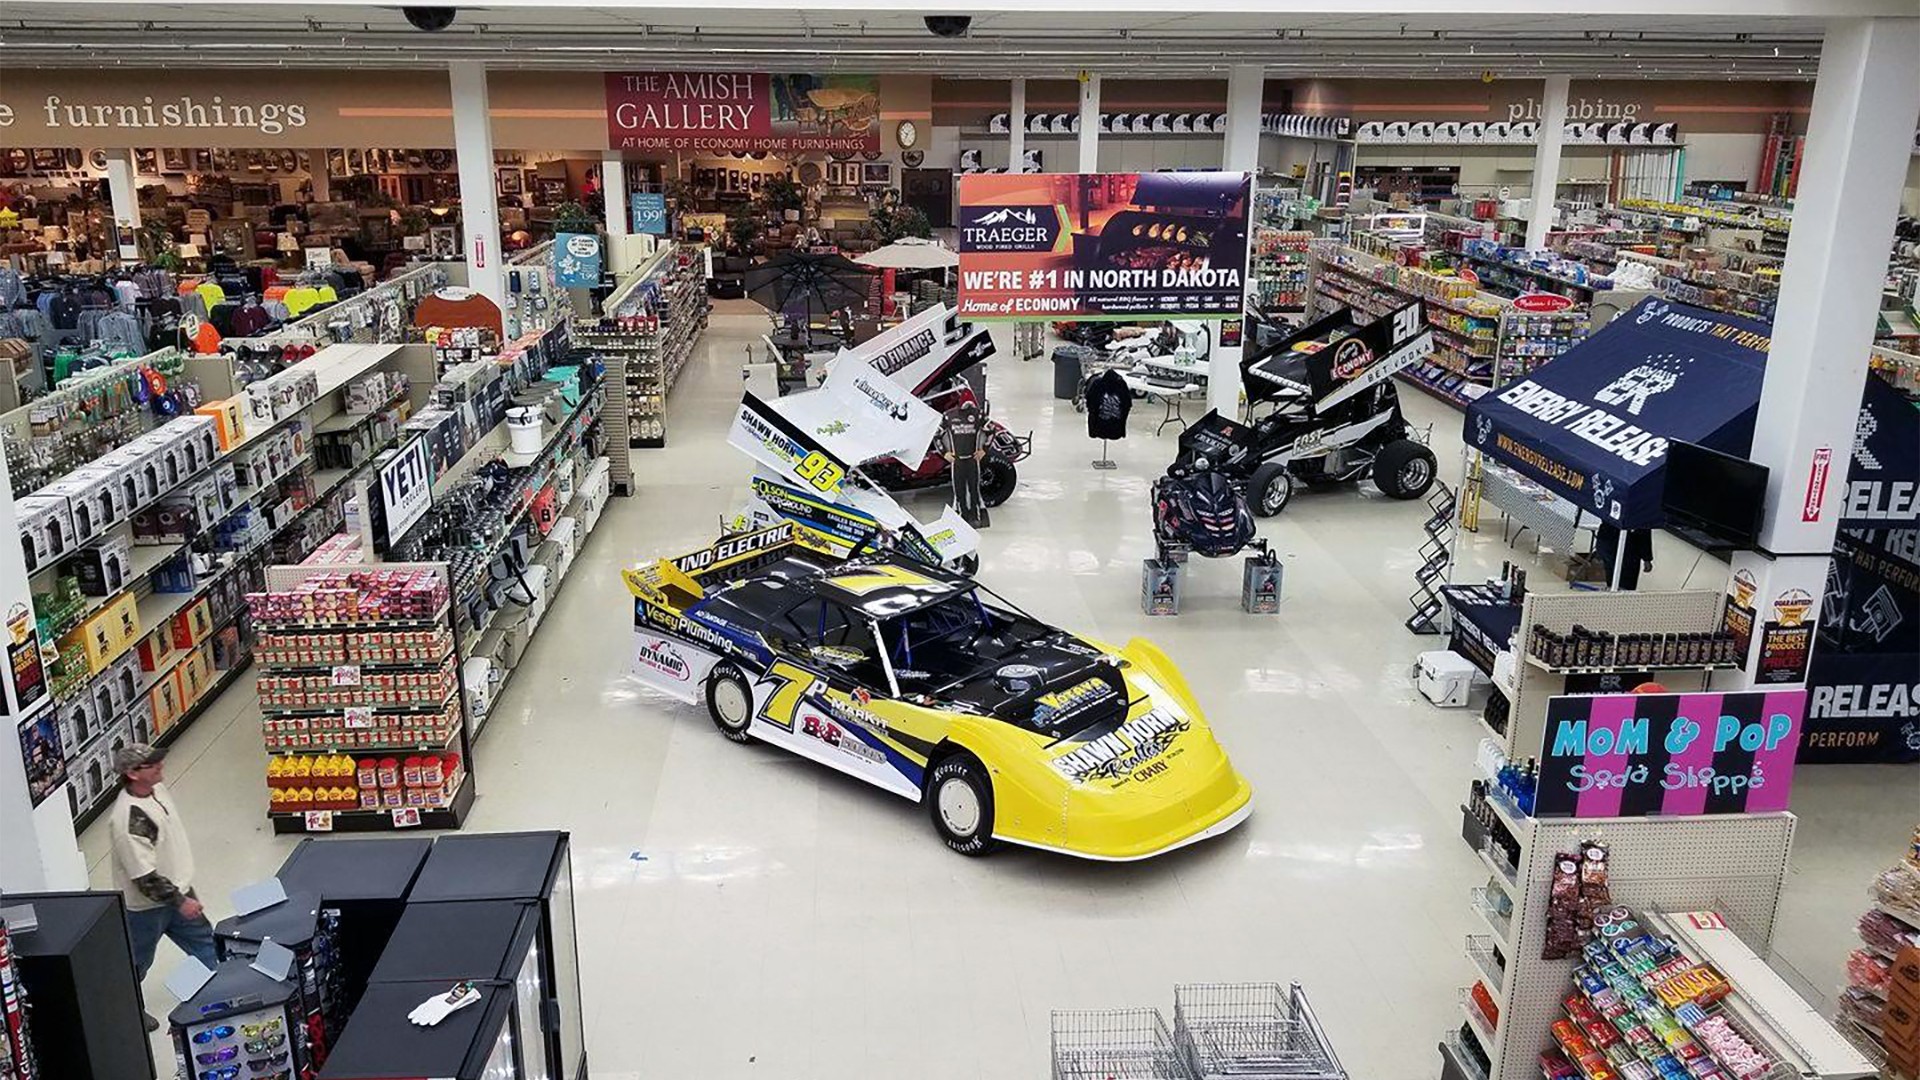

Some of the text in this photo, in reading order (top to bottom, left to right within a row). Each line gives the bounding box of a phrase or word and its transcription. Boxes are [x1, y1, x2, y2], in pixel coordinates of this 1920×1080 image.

[622, 72, 752, 99] THE AMISH
[44, 97, 307, 134] furnishings
[615, 103, 755, 131] GALLERY
[622, 138, 865, 151] AT HOME OF ECONOMY HOME FURNISHINGS
[963, 227, 1049, 243] TRAEGER
[963, 267, 1241, 290] WE'RE #1 IN NORTH DAKOTA
[961, 298, 1080, 313] Home of ECONOMY
[1393, 302, 1421, 344] 20
[1660, 312, 1712, 333] PRODUCTS
[1708, 323, 1738, 340] THAT
[886, 330, 936, 363] FINANCE
[1332, 348, 1375, 380] ECONOMY
[1367, 365, 1388, 383] BET
[741, 409, 772, 439] SHAWN
[771, 433, 797, 458] HORN
[1497, 379, 1670, 467] ENERGY RELEASE
[1291, 427, 1324, 456] FAST
[383, 443, 423, 508] YETI
[794, 450, 846, 492] 93
[717, 523, 793, 561] ELECTRIC
[1766, 643, 1806, 651] PRODUCTS
[1768, 634, 1807, 643] THE BEST
[639, 645, 683, 672] DYNAMIC
[802, 715, 843, 748] B&E
[1051, 706, 1181, 776] SHAWN HORN
[1663, 716, 1701, 754] &
[1809, 731, 1880, 748] PERFORM
[1133, 759, 1169, 782] CRARY
[1566, 763, 1650, 792] Soda
